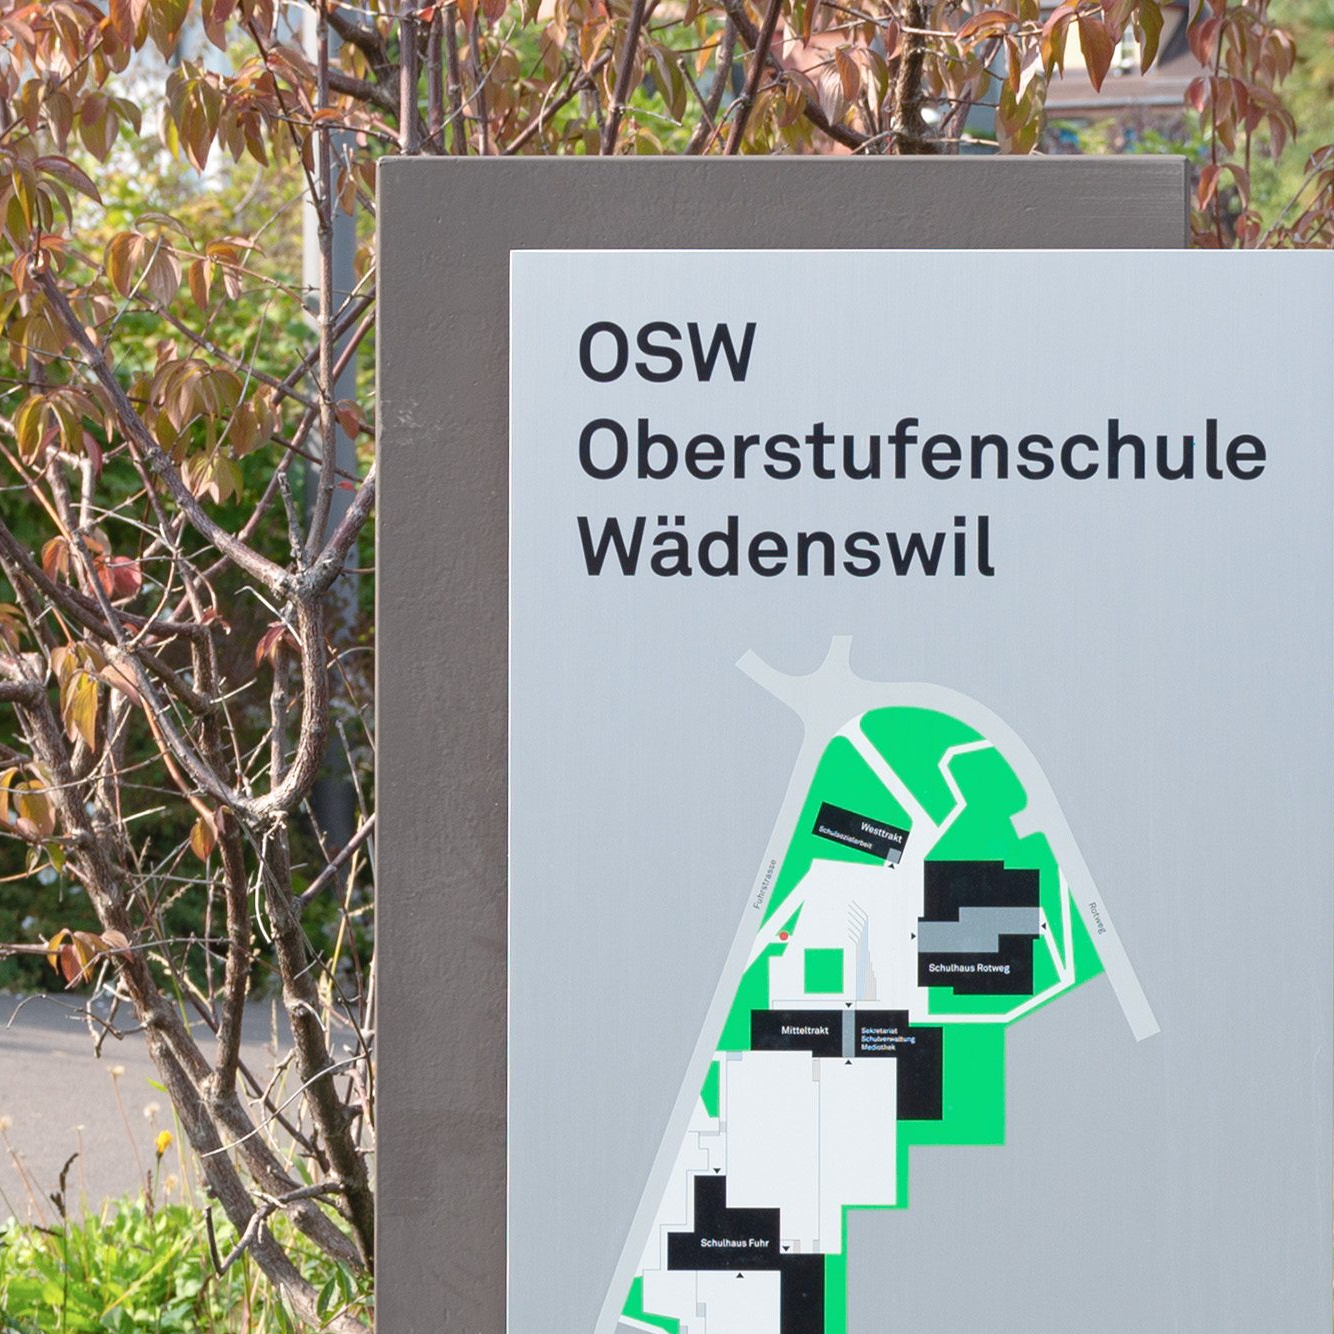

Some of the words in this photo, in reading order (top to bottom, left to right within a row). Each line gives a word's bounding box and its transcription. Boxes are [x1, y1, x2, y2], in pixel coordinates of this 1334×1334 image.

[580, 322, 756, 382] OSW
[579, 418, 1266, 480] Oberstufenschule
[577, 516, 994, 577] Wädenswil
[861, 821, 903, 844] Westtrakt
[752, 859, 777, 910] Fuhrstrasse
[1088, 901, 1107, 935] Rotweg
[928, 963, 976, 974] Schulhaus
[977, 963, 1011, 975] Rotweg
[781, 1025, 829, 1036] Mitteltrakt
[861, 1027, 898, 1035] Sekretariat
[861, 1035, 916, 1044] Schulverwaltung
[861, 1043, 896, 1051] Mediothek
[700, 1238, 747, 1248] Schulhaus
[748, 1238, 770, 1248] Fuhr
